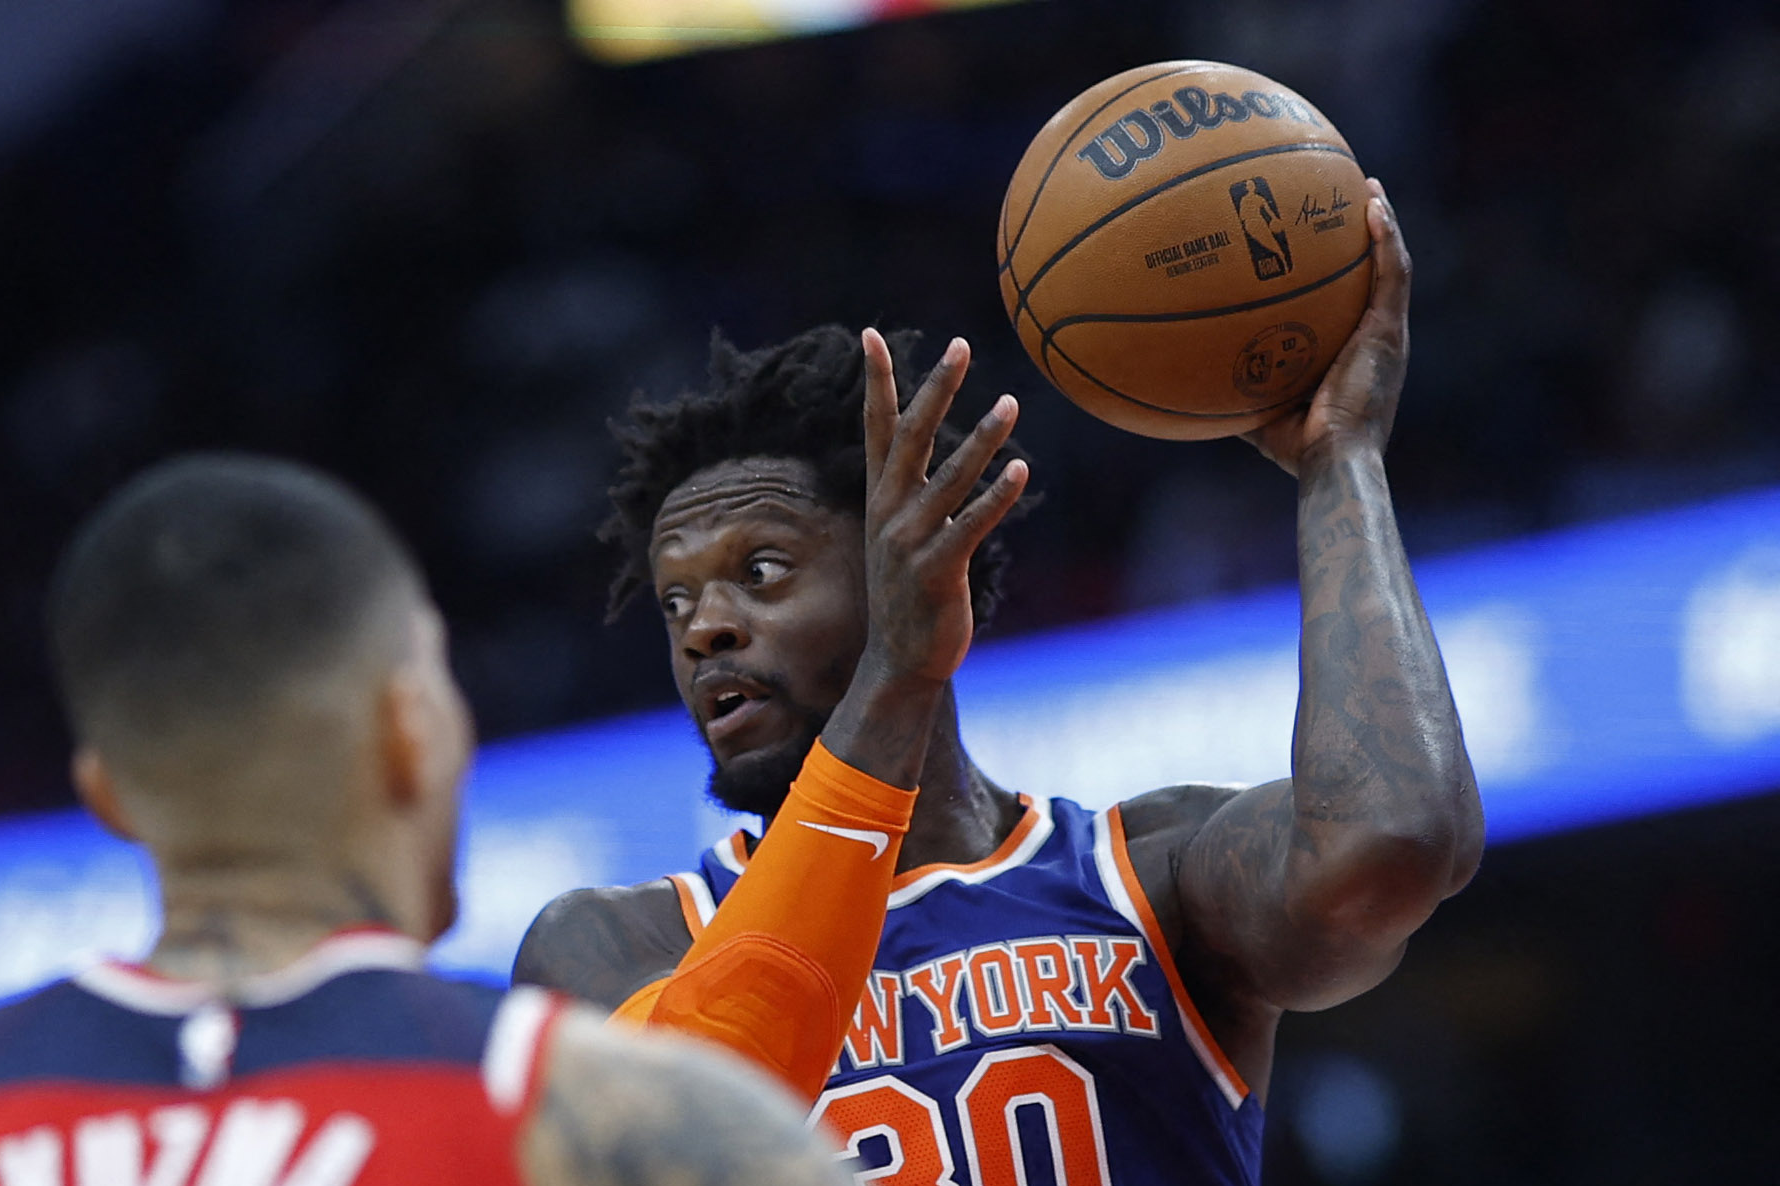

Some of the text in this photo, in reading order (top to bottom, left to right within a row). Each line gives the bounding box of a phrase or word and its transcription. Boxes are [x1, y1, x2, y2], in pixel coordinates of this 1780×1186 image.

[1075, 85, 1324, 181] Wilson
[1145, 245, 1184, 269] OFFICIAL
[1210, 230, 1232, 249] BALL
[907, 934, 1162, 1055] YORK
